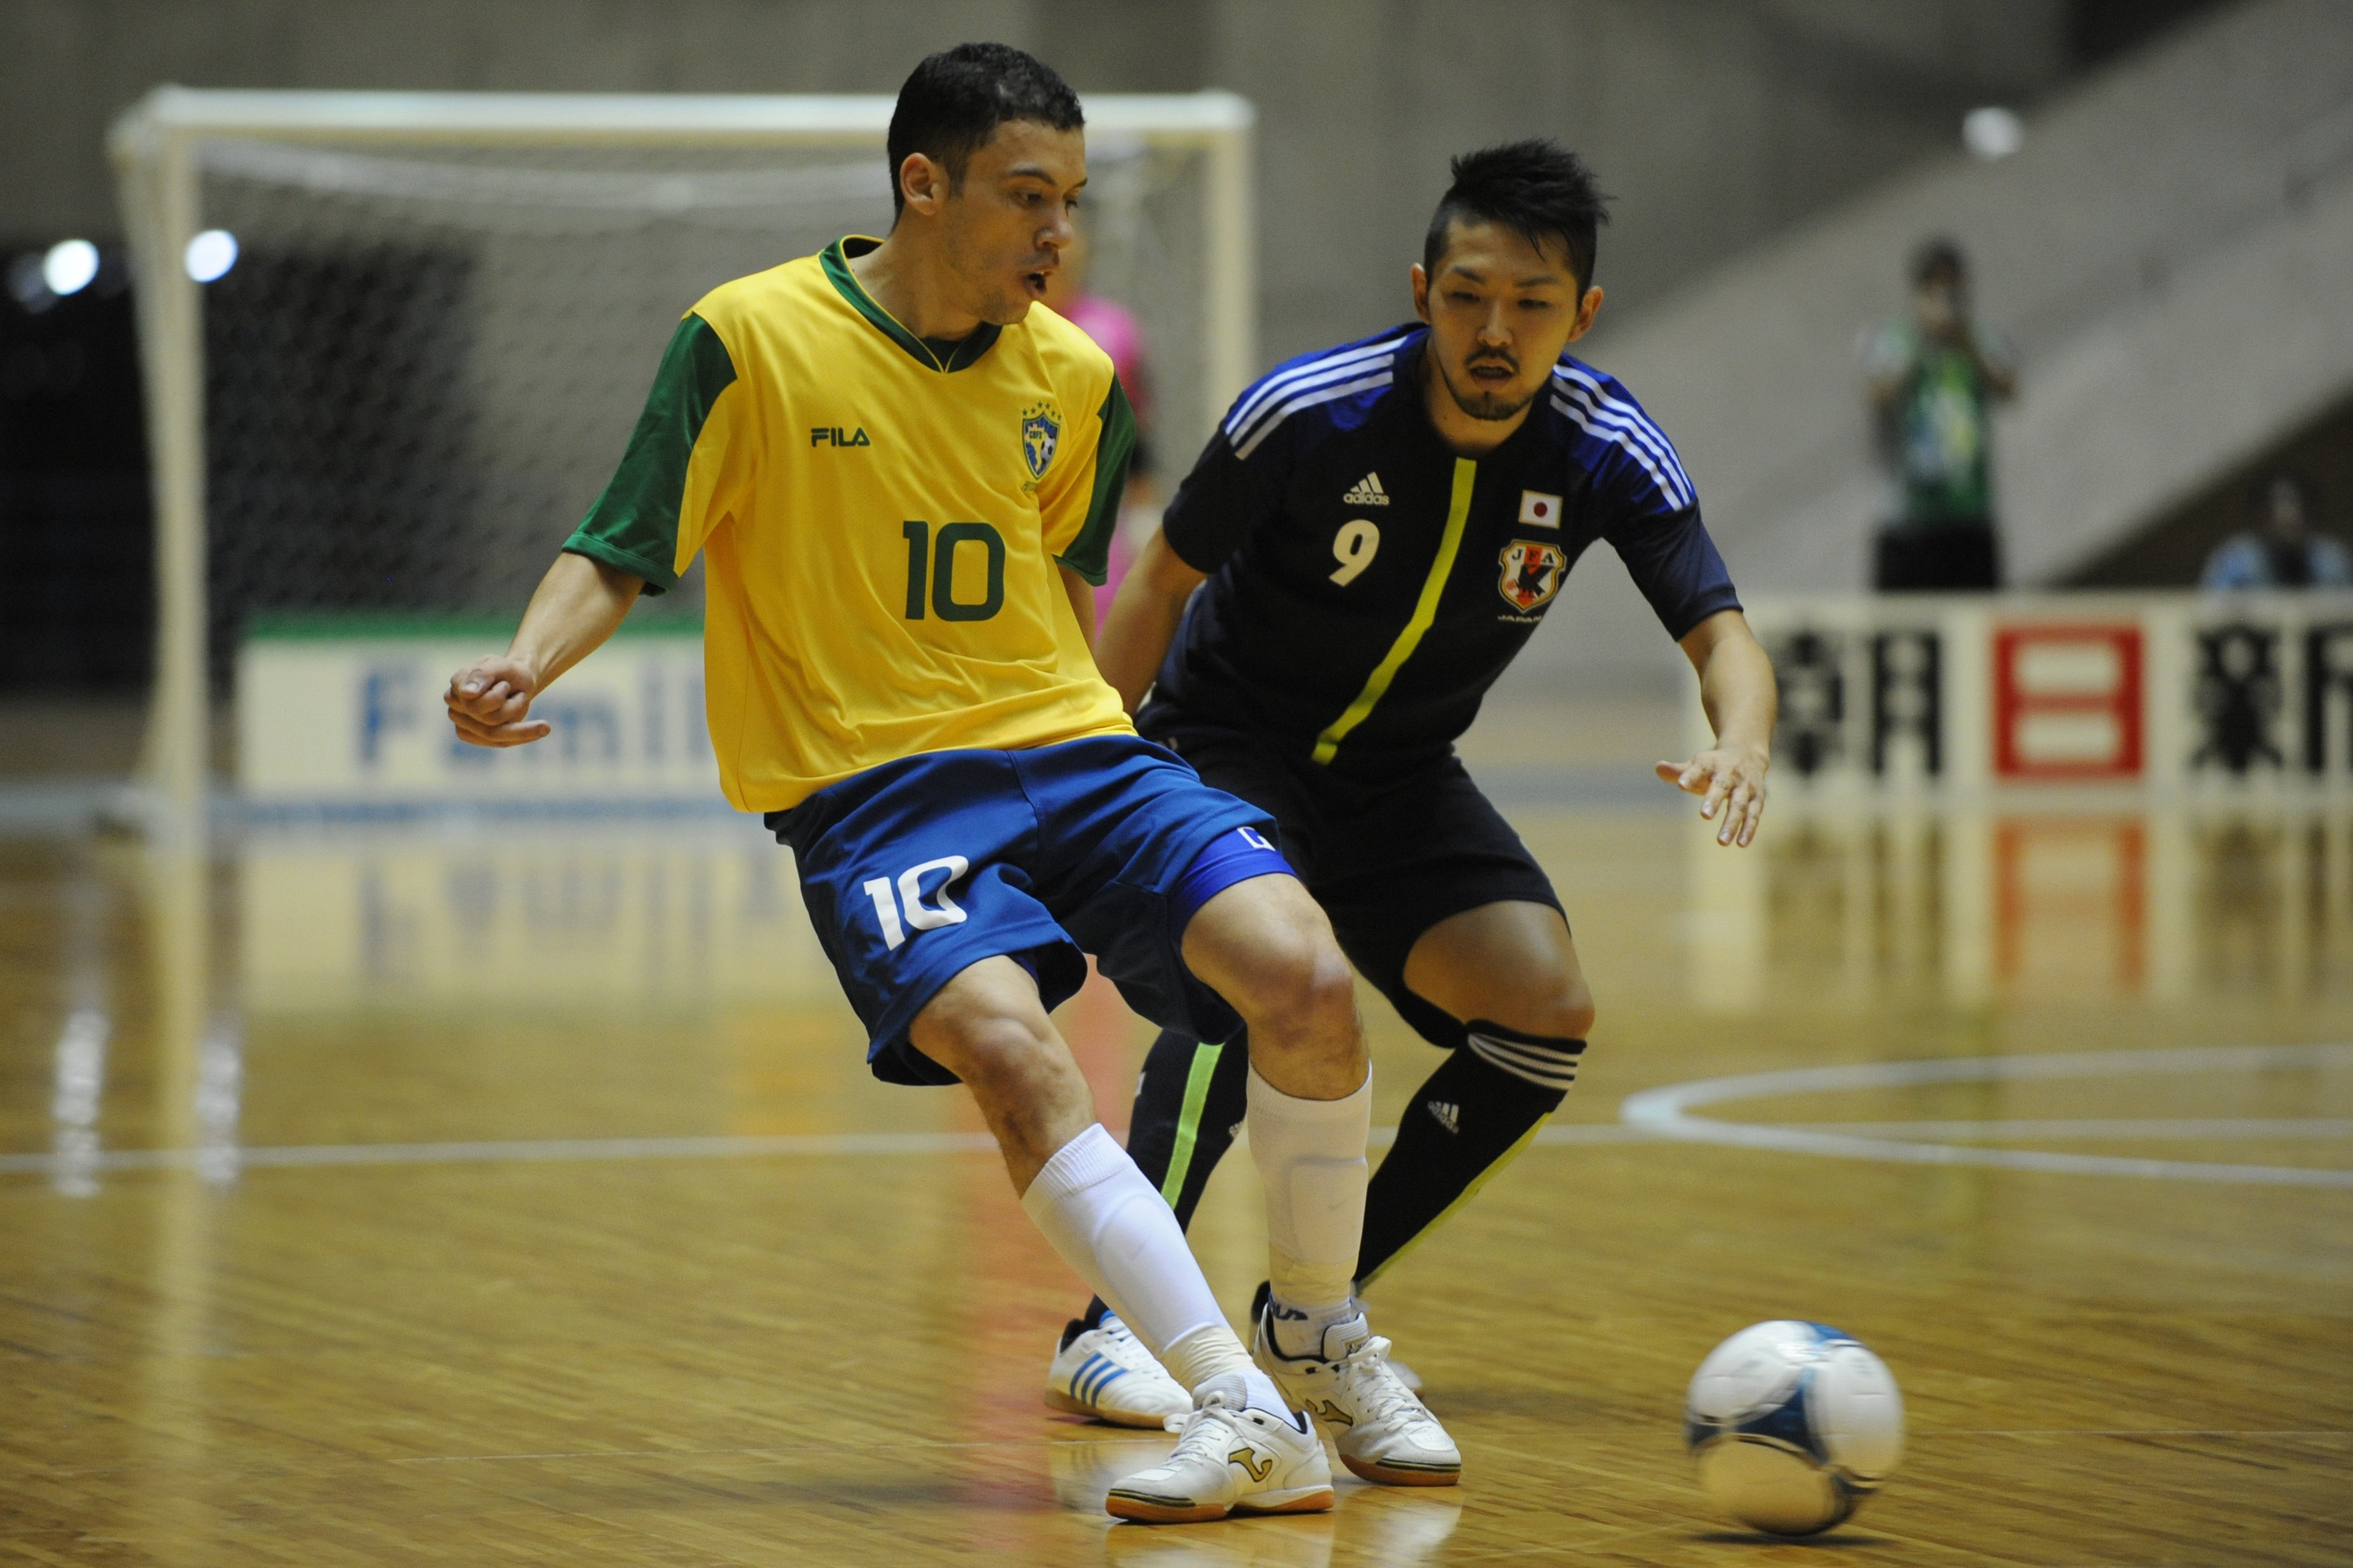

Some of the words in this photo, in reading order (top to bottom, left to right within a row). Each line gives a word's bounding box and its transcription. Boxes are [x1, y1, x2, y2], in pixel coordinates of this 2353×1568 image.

[811, 426, 870, 447] FILA
[1343, 491, 1390, 505] adidas
[1329, 519, 1380, 587] 9
[1511, 548, 1554, 564] JFA
[903, 520, 1005, 621] 10
[863, 855, 969, 951] 10
[1428, 1100, 1460, 1134] adidas
